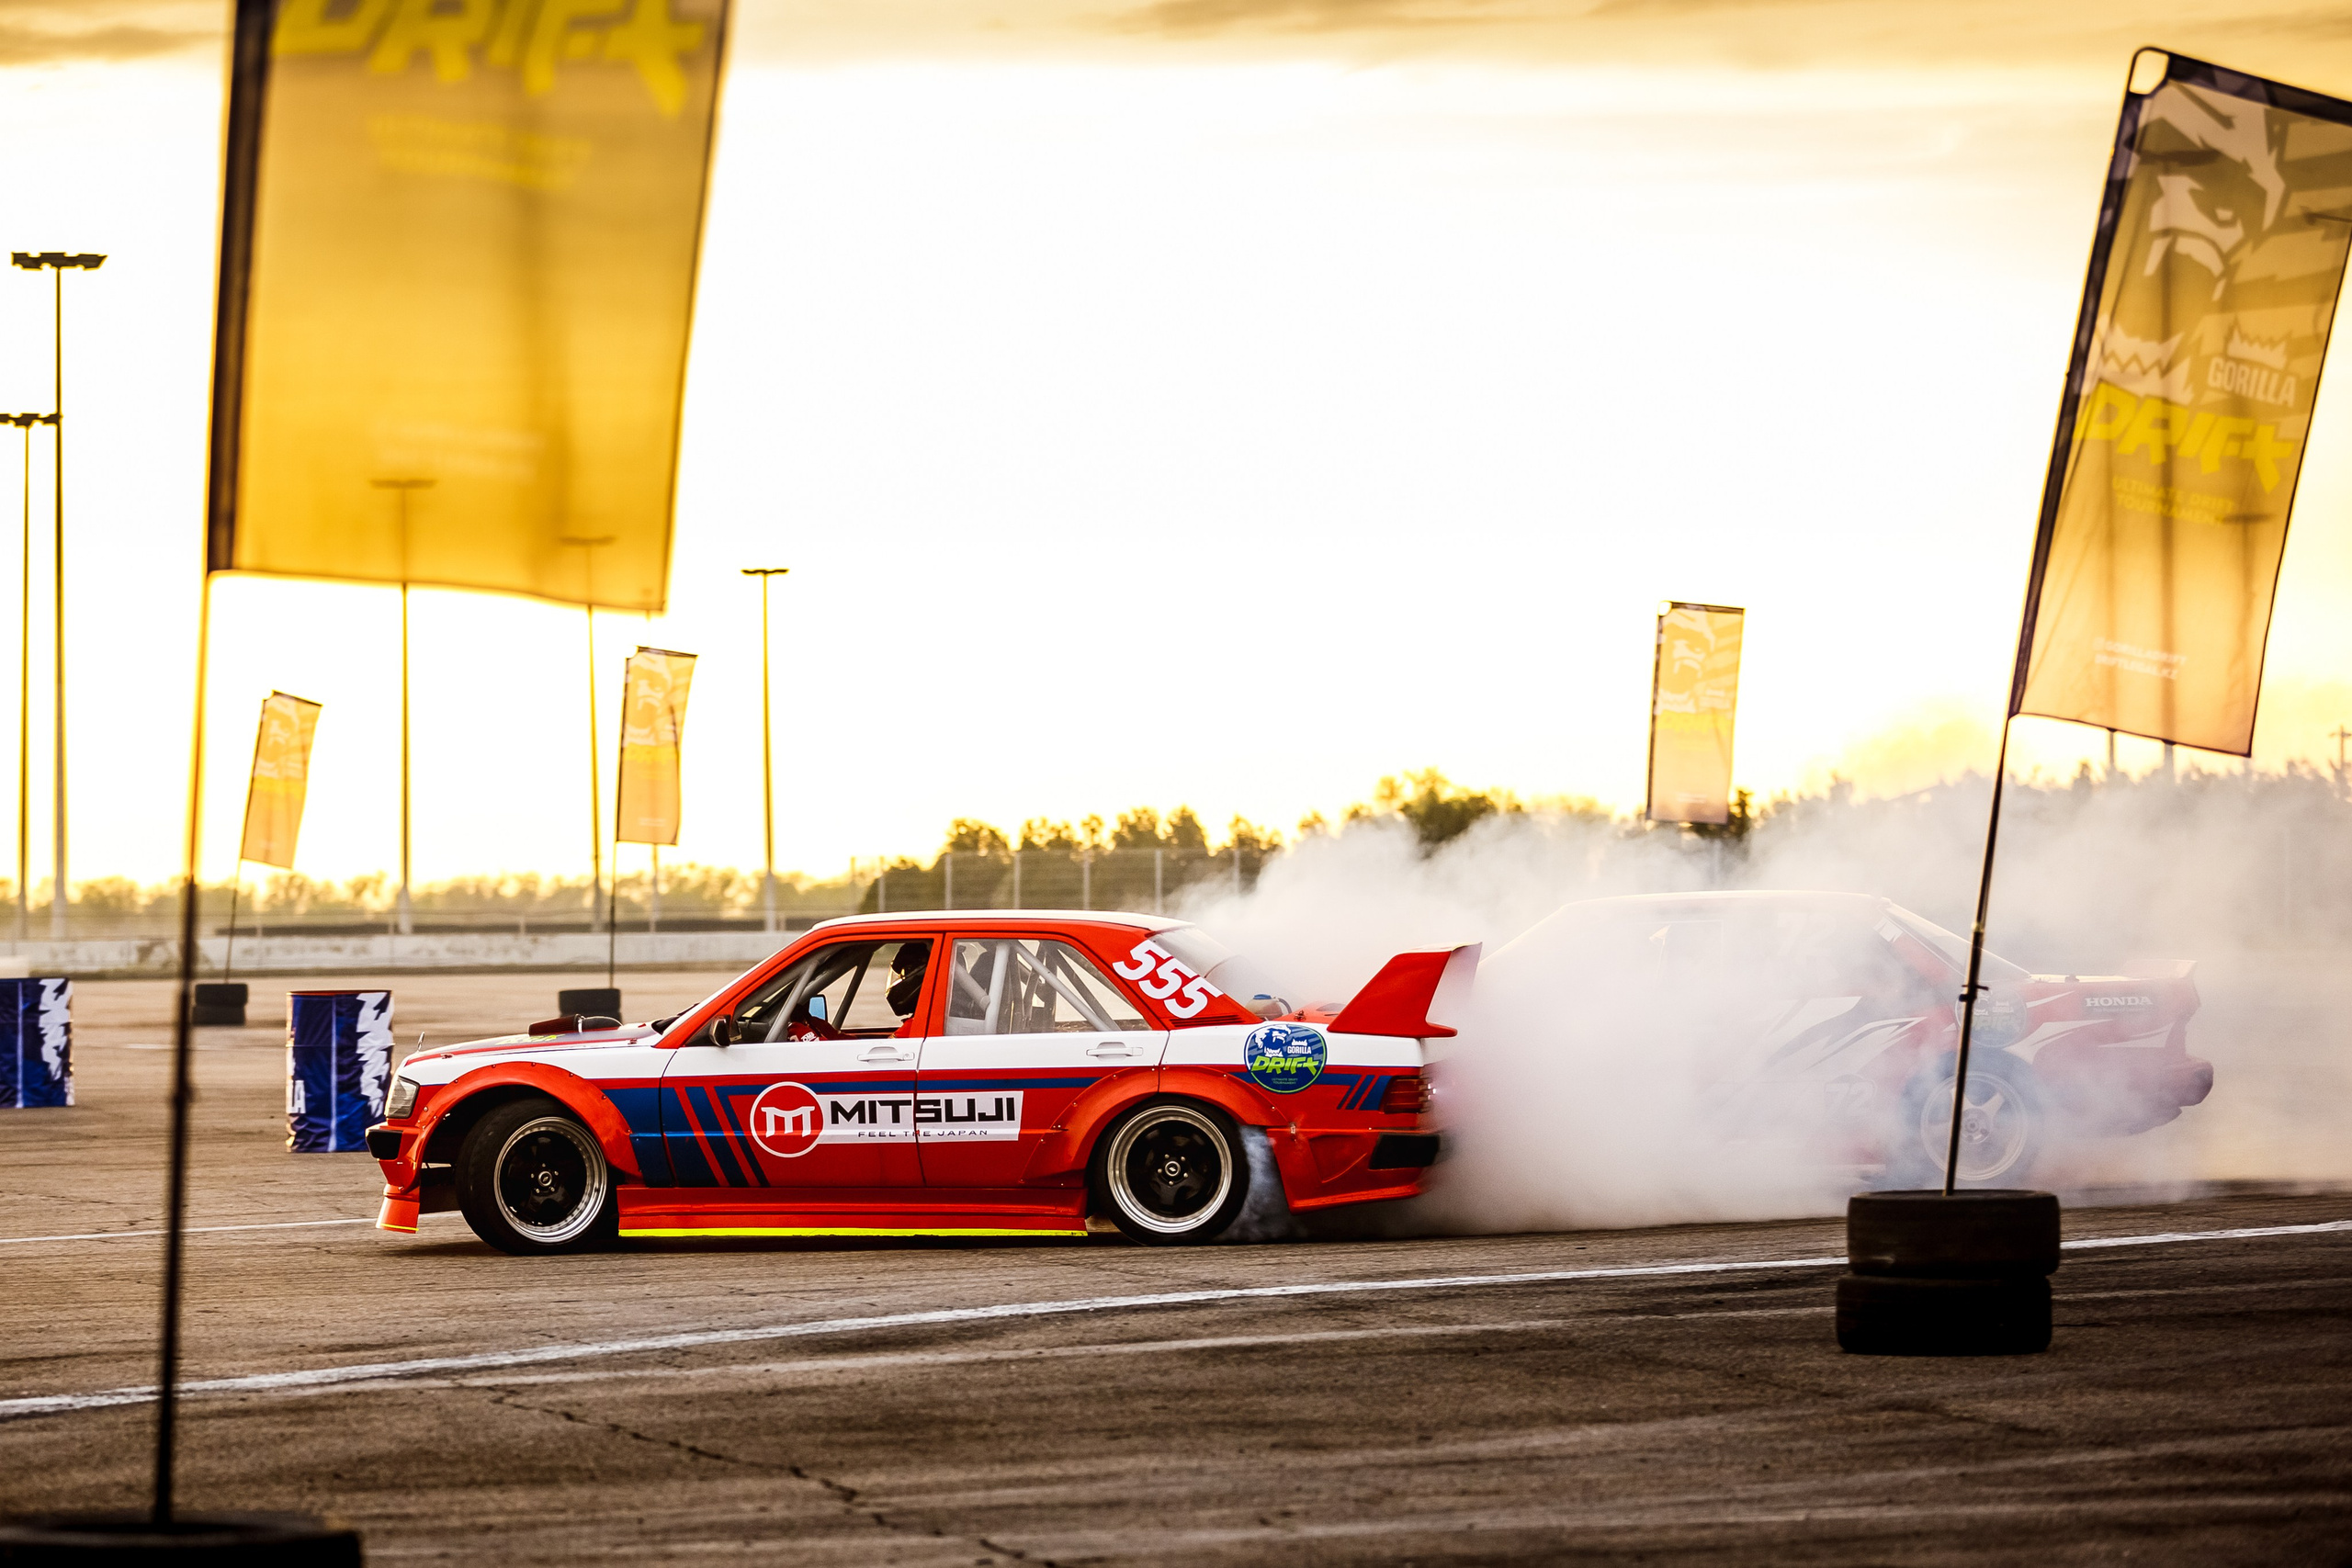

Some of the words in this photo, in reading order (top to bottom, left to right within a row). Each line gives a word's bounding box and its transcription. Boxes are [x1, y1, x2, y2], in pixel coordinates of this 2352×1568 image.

[2207, 355, 2297, 408] GORILLA
[2073, 383, 2295, 495] DRIFT
[1113, 939, 1224, 1019] 555
[2085, 996, 2154, 1008] HONDA
[1287, 1045, 1312, 1055] GORILLA
[1250, 1055, 1319, 1076] DRIFT
[831, 1097, 1016, 1125] MITSUJI
[937, 1129, 989, 1137] JAPAN
